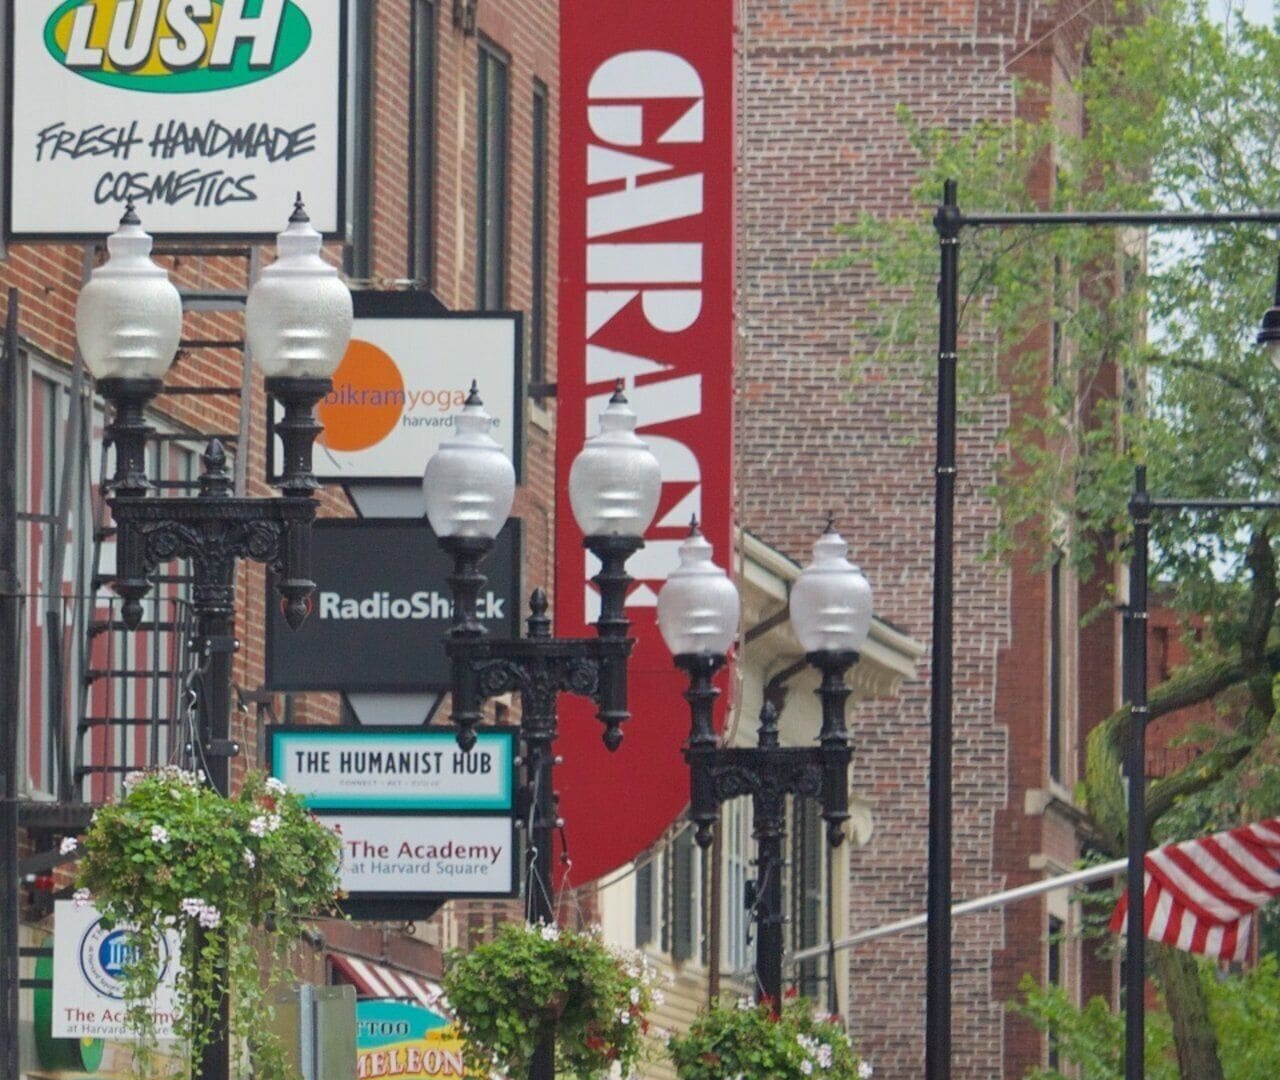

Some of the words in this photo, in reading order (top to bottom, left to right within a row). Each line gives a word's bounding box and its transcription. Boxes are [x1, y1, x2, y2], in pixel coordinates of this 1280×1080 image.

[64, 0, 286, 70] LUSH
[37, 120, 142, 161] FRESH
[149, 119, 317, 162] HANDMADE
[94, 169, 257, 206] COSMETICS
[403, 414, 500, 427] harvarde
[319, 591, 505, 619] RadioShck
[296, 751, 330, 774] THE
[340, 751, 442, 775] HUMANIST
[452, 752, 492, 775] HUB
[347, 840, 389, 858] The
[397, 841, 502, 864] Academy
[351, 862, 365, 874] at
[371, 861, 430, 874] Harvard
[436, 861, 488, 876] Square
[64, 1008, 96, 1022] The
[101, 1008, 179, 1024] Acamy
[358, 1021, 409, 1035] TOO
[67, 1024, 78, 1033] at
[357, 1047, 464, 1079] MELEON
